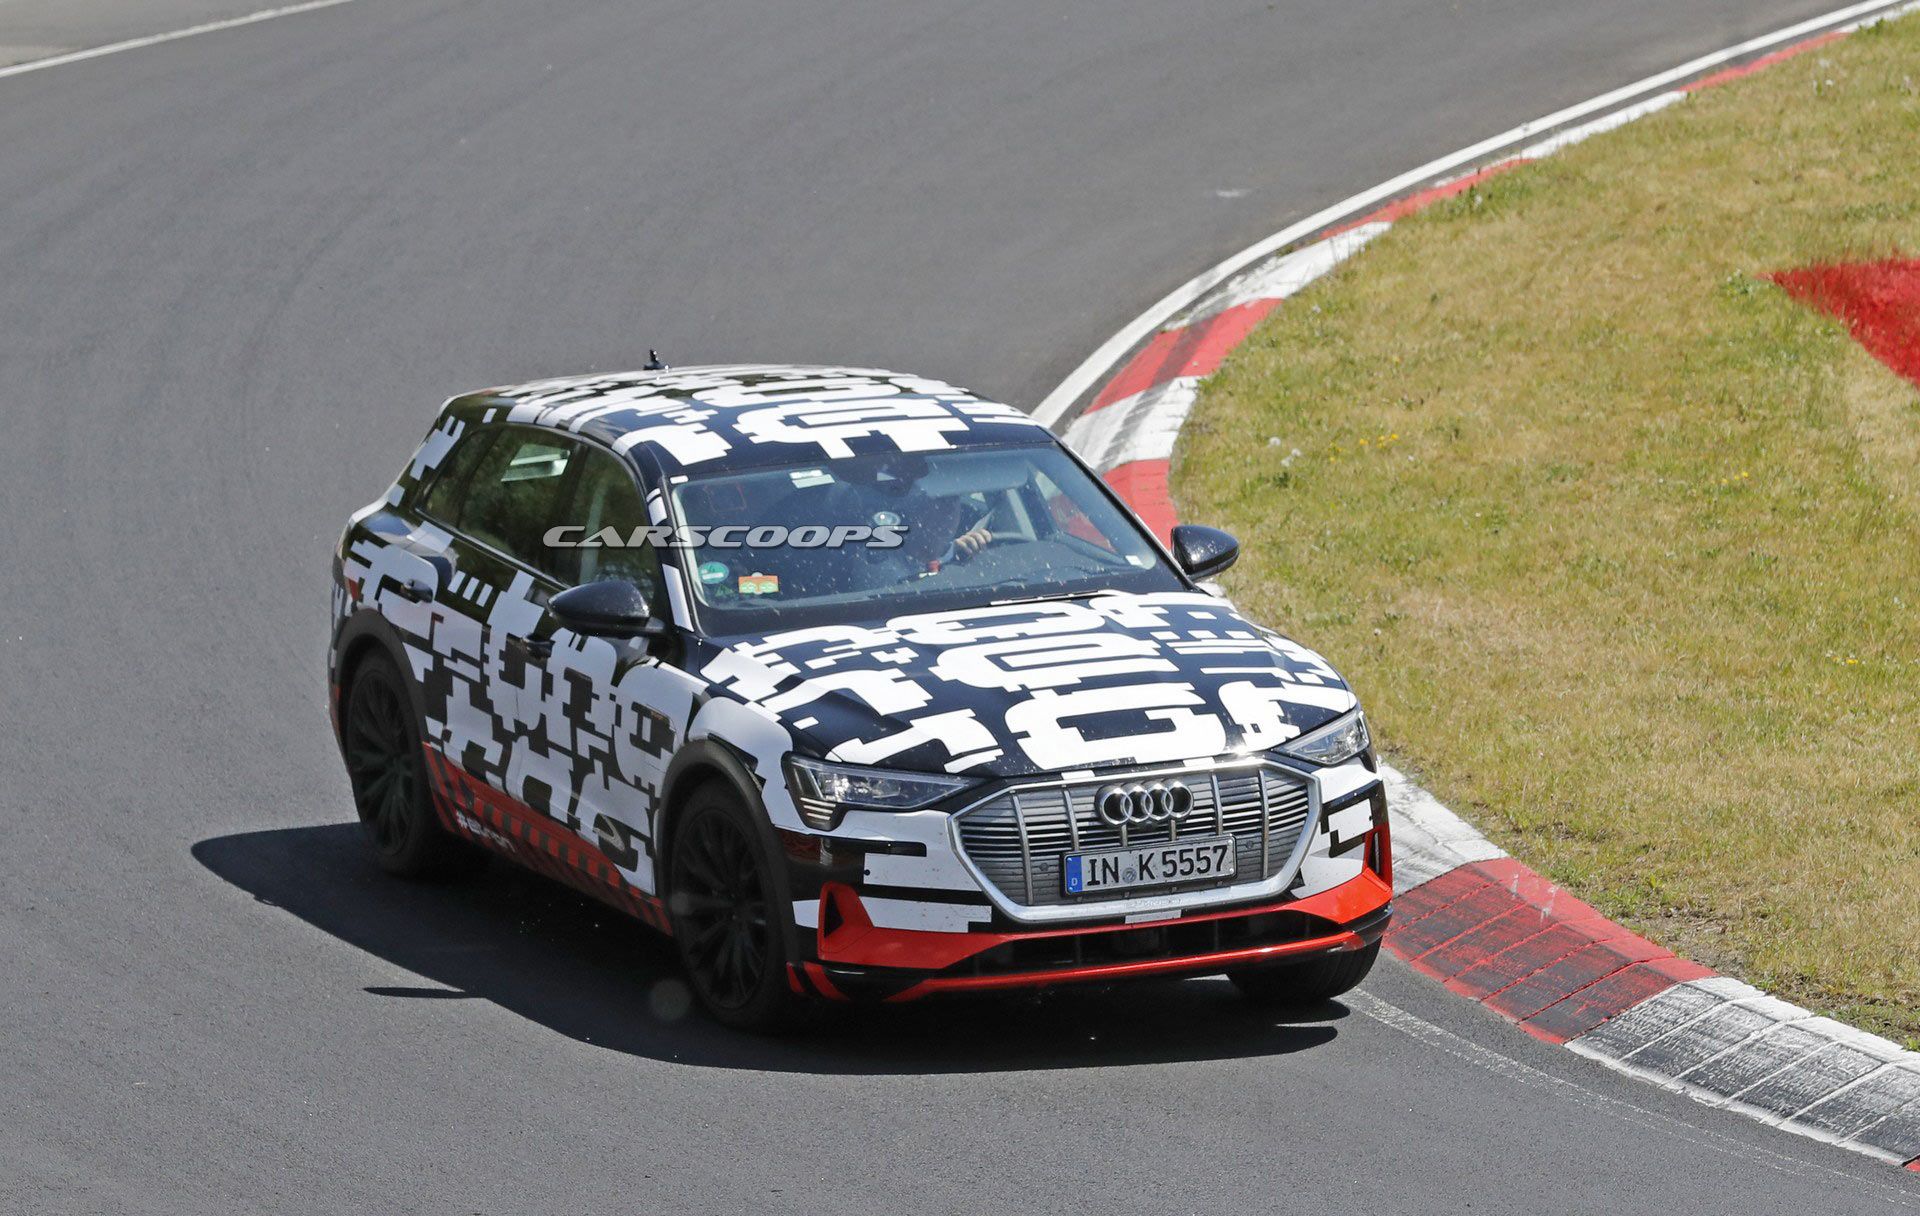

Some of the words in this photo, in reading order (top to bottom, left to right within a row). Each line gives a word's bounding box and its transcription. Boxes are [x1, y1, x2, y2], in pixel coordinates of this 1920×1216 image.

[1086, 856, 1120, 886] IN
[1138, 852, 1156, 881] K
[1162, 844, 1227, 878] 5557
[1071, 878, 1078, 887] D
